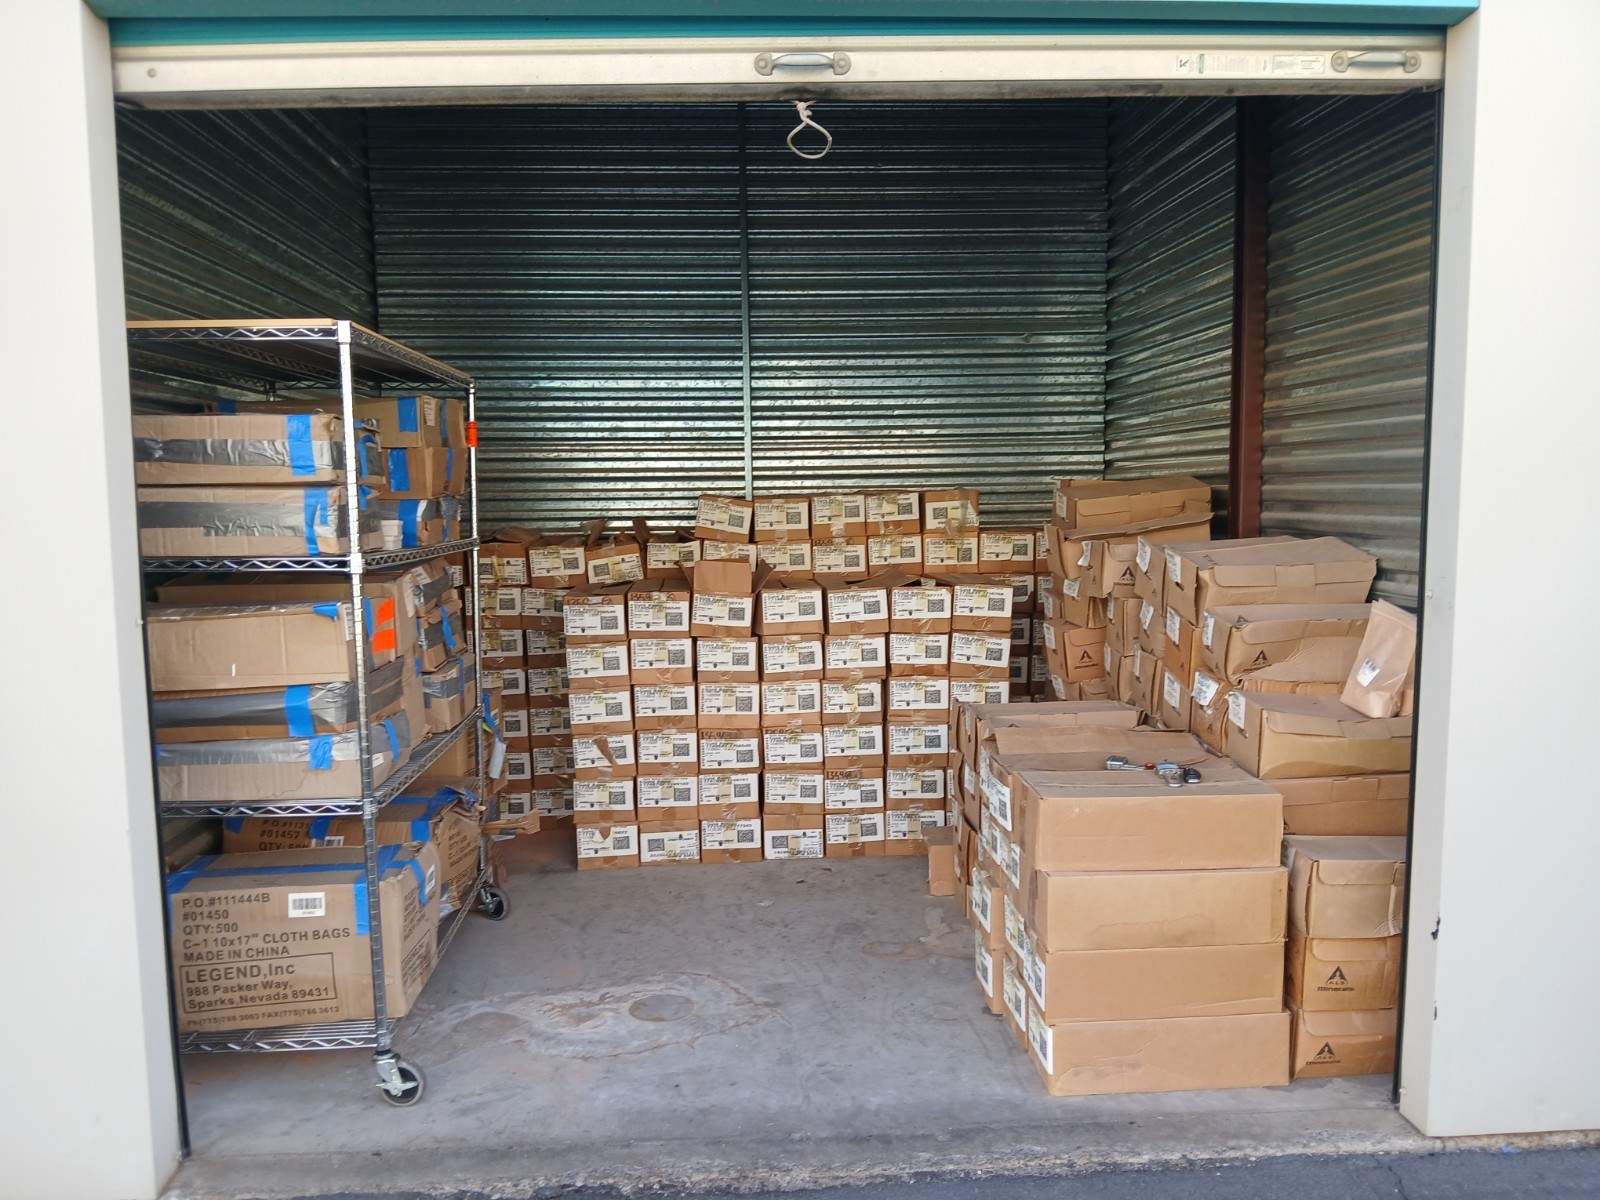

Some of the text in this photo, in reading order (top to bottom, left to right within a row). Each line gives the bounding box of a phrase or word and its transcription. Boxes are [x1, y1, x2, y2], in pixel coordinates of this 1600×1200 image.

[182, 892, 270, 908] P.O.#111444B
[182, 909, 229, 921] #01450
[182, 922, 239, 936] QTY:500
[212, 932, 259, 948] 10x17"
[262, 931, 309, 944] CLOTH
[312, 927, 350, 941] BAGS
[183, 946, 290, 962] MADE IN CHINA
[185, 963, 296, 984] LEGEND,Inc
[186, 985, 209, 997] 988
[212, 982, 259, 995] Packer
[291, 986, 329, 999] 89431
